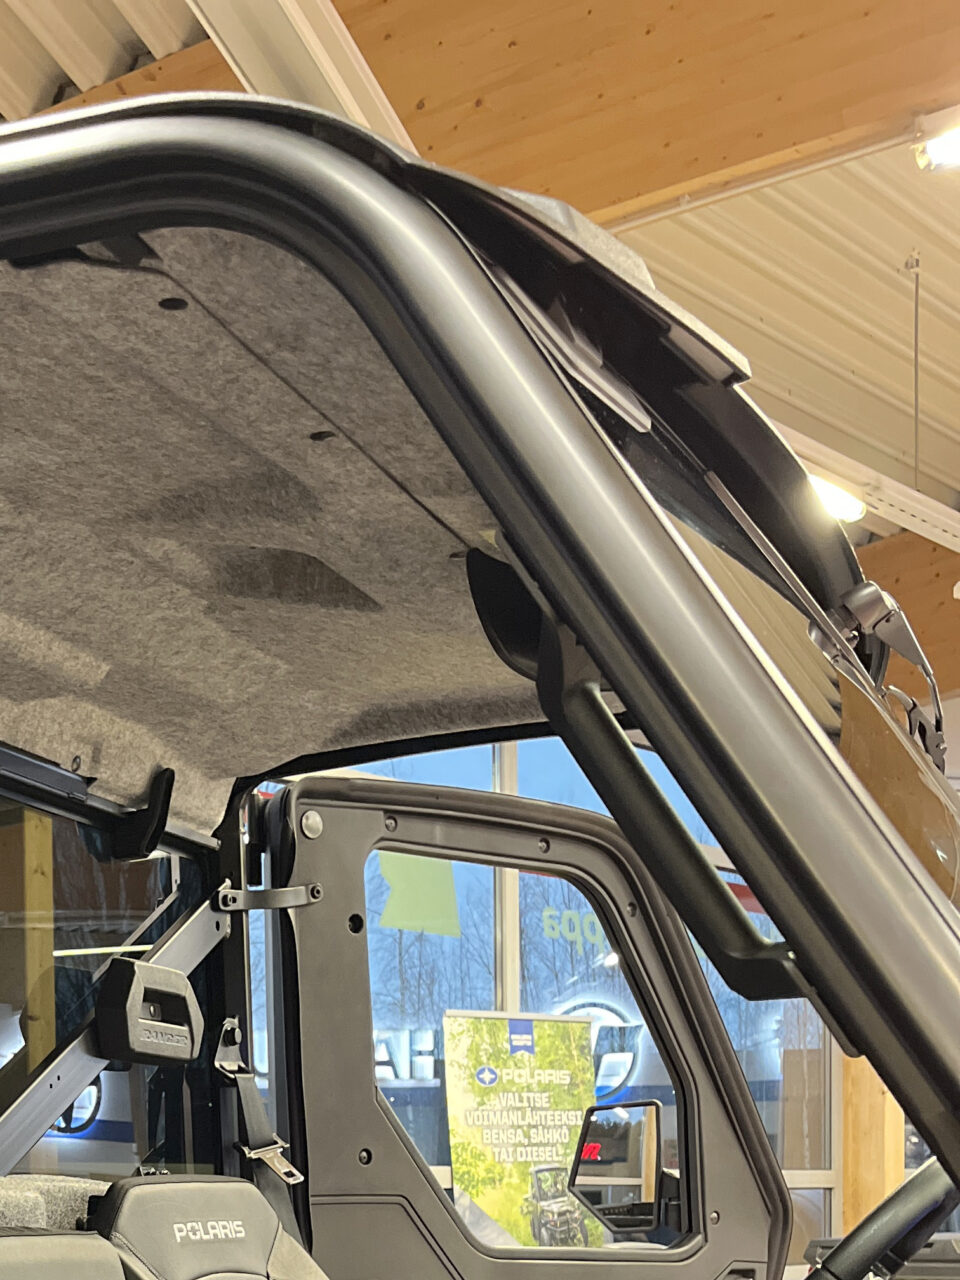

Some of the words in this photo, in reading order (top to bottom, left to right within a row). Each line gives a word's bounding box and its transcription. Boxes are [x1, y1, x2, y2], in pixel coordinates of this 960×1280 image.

[502, 1069, 571, 1084] POLARIS
[499, 1093, 550, 1107] VALITSE
[466, 1108, 583, 1126] VOIMANLÄHTEEKSI
[483, 1129, 528, 1145] BENSA,
[530, 1126, 569, 1144] SÄHKÖ
[493, 1148, 513, 1162] TAI
[173, 1220, 245, 1242] POLARIS
